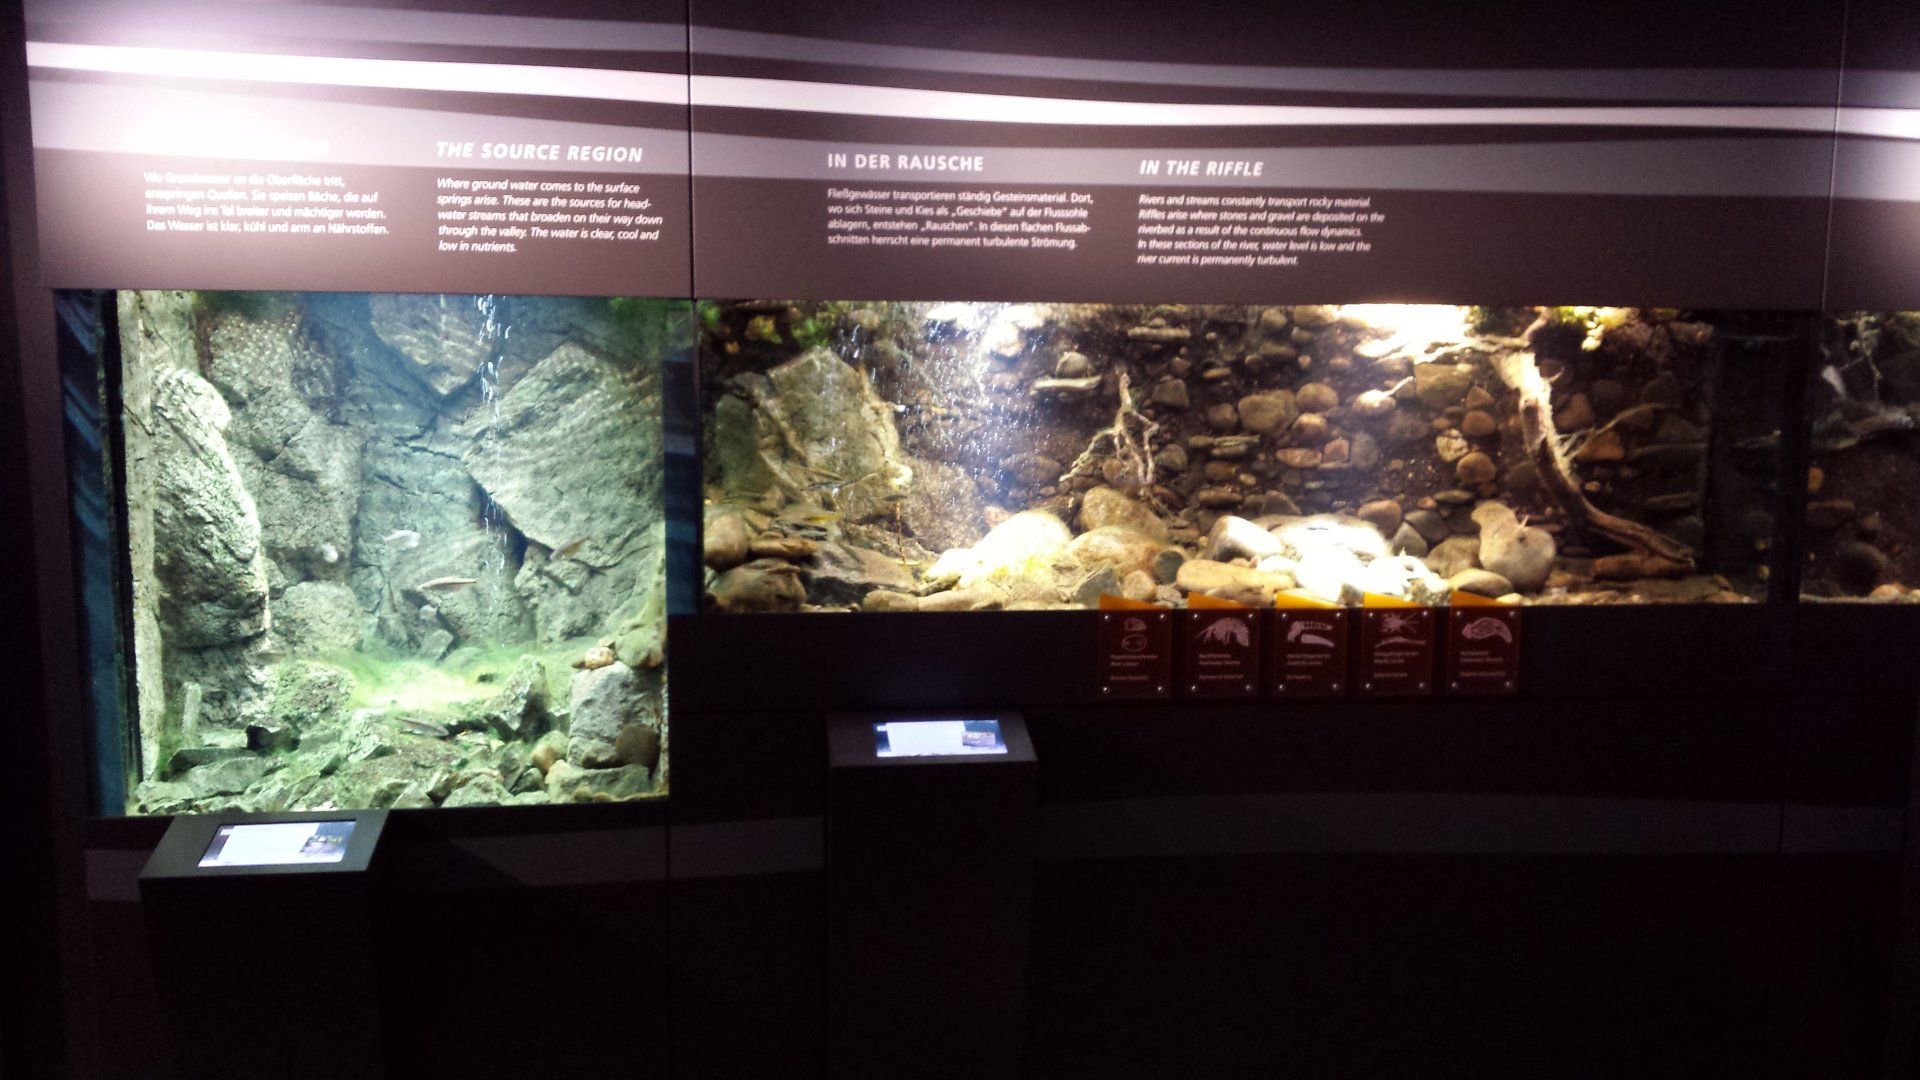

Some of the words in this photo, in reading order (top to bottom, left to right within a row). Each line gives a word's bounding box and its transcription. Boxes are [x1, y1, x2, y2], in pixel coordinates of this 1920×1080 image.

[437, 142, 474, 158] THE
[481, 143, 561, 160] SOURCE
[567, 146, 643, 162] REGION
[828, 153, 847, 168] IN
[855, 154, 890, 169] DER
[898, 155, 984, 171] RAUSCHE
[1140, 160, 1160, 175] IN
[1167, 161, 1199, 175] THE
[1206, 161, 1264, 176] RIFFLE
[437, 178, 469, 189] Where
[472, 179, 507, 191] ground
[510, 181, 538, 190] water
[540, 183, 571, 191] comes
[574, 182, 584, 192] to
[587, 182, 602, 192] the
[605, 182, 640, 194] surface
[437, 194, 471, 206] springs
[474, 195, 499, 205] arise.
[503, 195, 530, 206] These
[533, 198, 549, 206] are
[551, 197, 567, 207] the
[569, 199, 604, 208] sources
[607, 198, 621, 209] for
[893, 190, 955, 201] transportieren
[958, 190, 990, 203] ständig
[993, 192, 1067, 203] Gesteinsmaterial.
[1071, 193, 1093, 204] Dort,
[1139, 195, 1164, 204] Rivers
[1167, 195, 1184, 205] and
[1186, 196, 1219, 205] streams
[1221, 196, 1266, 208] constantly
[1268, 197, 1307, 208] transport
[1309, 197, 1332, 209] rocky
[845, 204, 862, 214] sich
[865, 204, 892, 214] Steine
[895, 205, 912, 215] und
[915, 206, 934, 215] Kies
[936, 206, 948, 215] als
[1010, 207, 1025, 217] auf
[1028, 207, 1042, 217] der
[1139, 210, 1165, 219] Riffles
[1167, 211, 1187, 219] arise
[1190, 211, 1217, 220] where
[1220, 212, 1247, 221] stones
[1250, 212, 1266, 221] and
[1268, 212, 1294, 224] gravel
[1297, 214, 1310, 222] are
[1313, 213, 1355, 224] deposited
[1370, 213, 1385, 222] the
[438, 211, 466, 220] water
[469, 212, 505, 221] streams
[509, 211, 528, 221] that
[531, 212, 571, 222] broaden
[589, 213, 611, 223] their
[613, 216, 633, 226] way
[635, 214, 663, 224] down
[439, 226, 478, 238] through
[481, 227, 496, 236] the
[499, 227, 527, 239] valley.
[531, 228, 548, 237] The
[550, 230, 578, 238] water
[591, 229, 615, 240] clear,
[617, 229, 638, 239] cool
[640, 230, 659, 239] and
[873, 220, 917, 230] entstehen
[990, 222, 1018, 231] diesen
[1021, 222, 1053, 232] flachen
[1138, 225, 1174, 234] riverbed
[1195, 226, 1220, 235] result
[1222, 225, 1231, 235] of
[1234, 226, 1248, 235] the
[1250, 227, 1297, 236] continuous
[1300, 227, 1319, 236] flow
[439, 241, 457, 250] low
[459, 241, 469, 251] in
[471, 242, 516, 252] nutrients.
[828, 234, 869, 244] schnitten
[872, 235, 908, 245] herrscht
[911, 237, 930, 245] eine
[932, 236, 980, 248] permanent
[983, 237, 1028, 247] turbulente
[1031, 237, 1077, 249] Strömung.
[1149, 240, 1172, 249] these
[1174, 240, 1209, 250] sections
[1211, 240, 1222, 250] of
[1223, 241, 1238, 250] the
[1262, 242, 1287, 251] water
[1290, 242, 1309, 251] level
[1320, 242, 1335, 252] low
[1337, 242, 1354, 252] and
[1357, 242, 1370, 251] the
[1138, 255, 1157, 263] river
[1159, 256, 1190, 264] current
[1201, 256, 1255, 267] permanently
[1257, 256, 1299, 265] turbulent.
